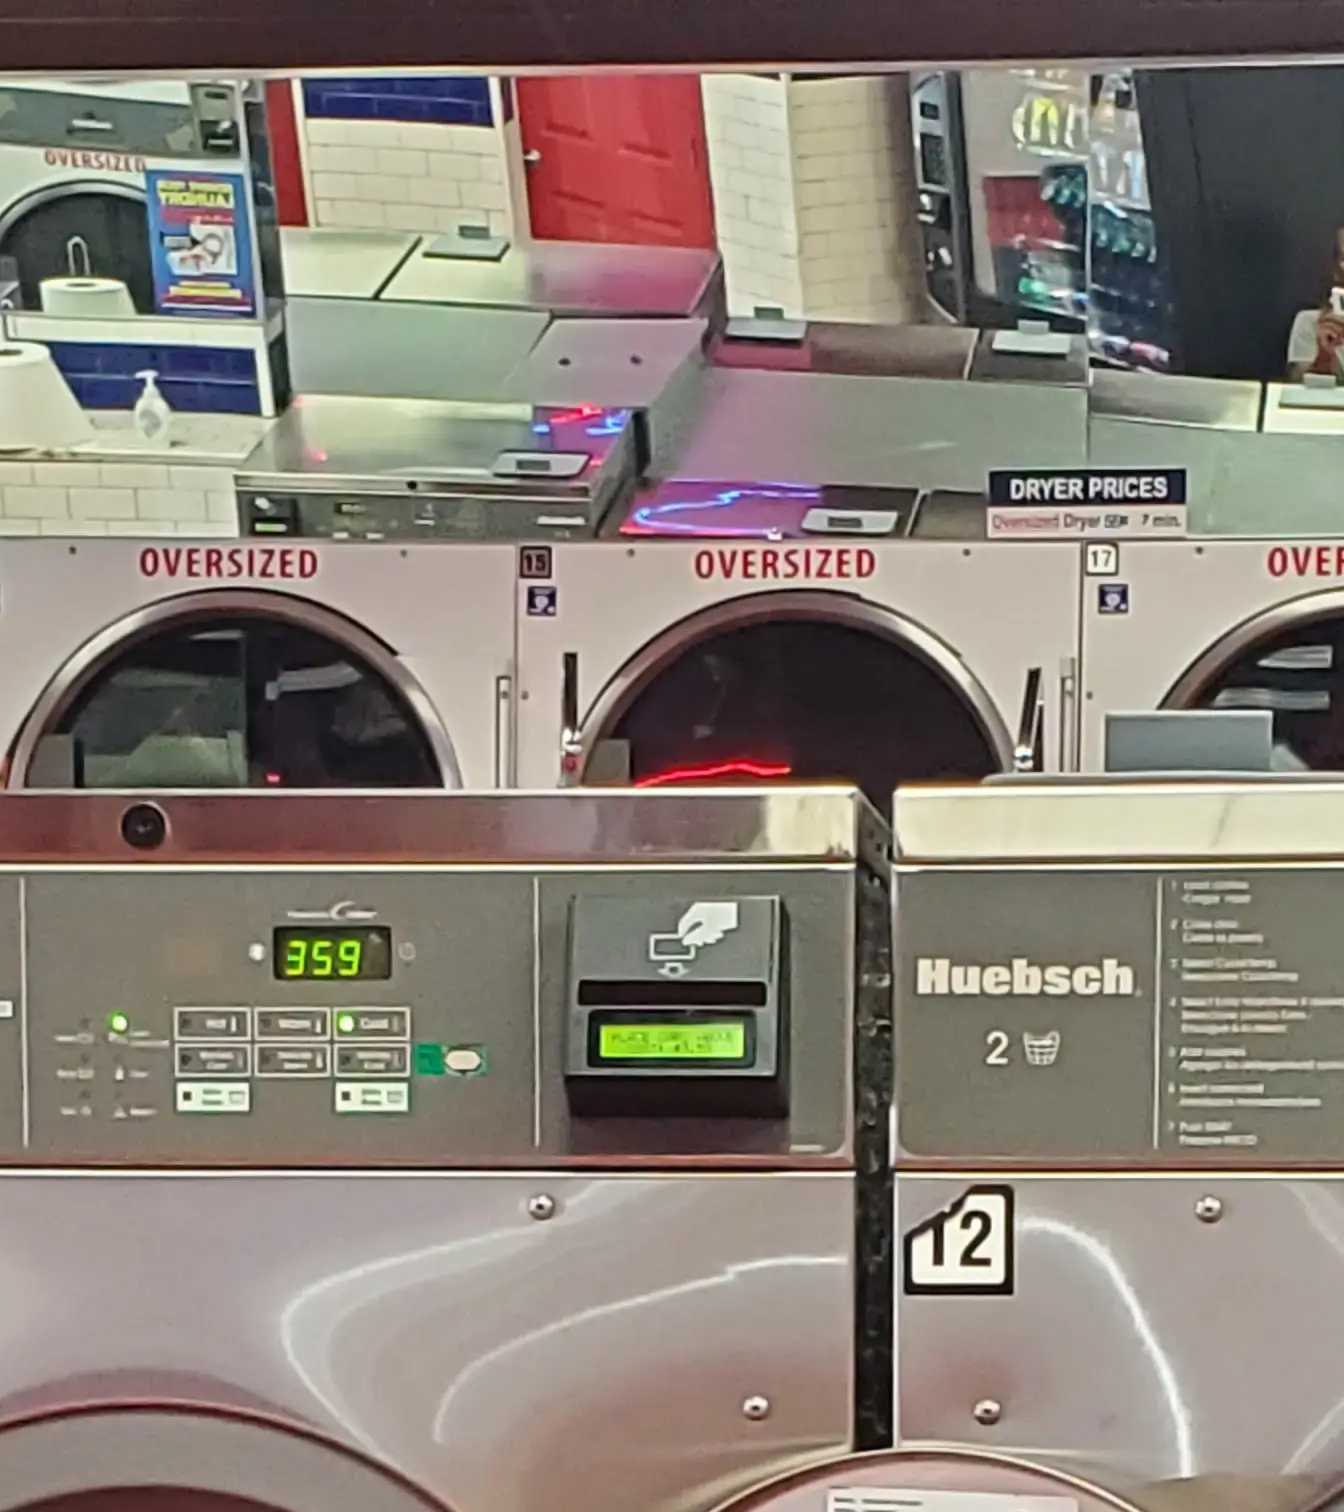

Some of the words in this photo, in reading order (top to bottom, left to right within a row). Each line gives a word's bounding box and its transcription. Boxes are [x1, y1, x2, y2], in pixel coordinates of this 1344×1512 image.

[1010, 478, 1084, 500] DRYER
[1088, 477, 1168, 498] PRICES
[1064, 514, 1101, 532] Dryer
[140, 548, 318, 578] OVERSIZED
[524, 553, 547, 573] 15
[695, 549, 876, 579] OVERSIZED
[1091, 549, 1113, 568] 17
[285, 940, 361, 976] 359
[916, 958, 1134, 995] Huebsch
[985, 1031, 1009, 1065] 2
[924, 1209, 993, 1267] 12
